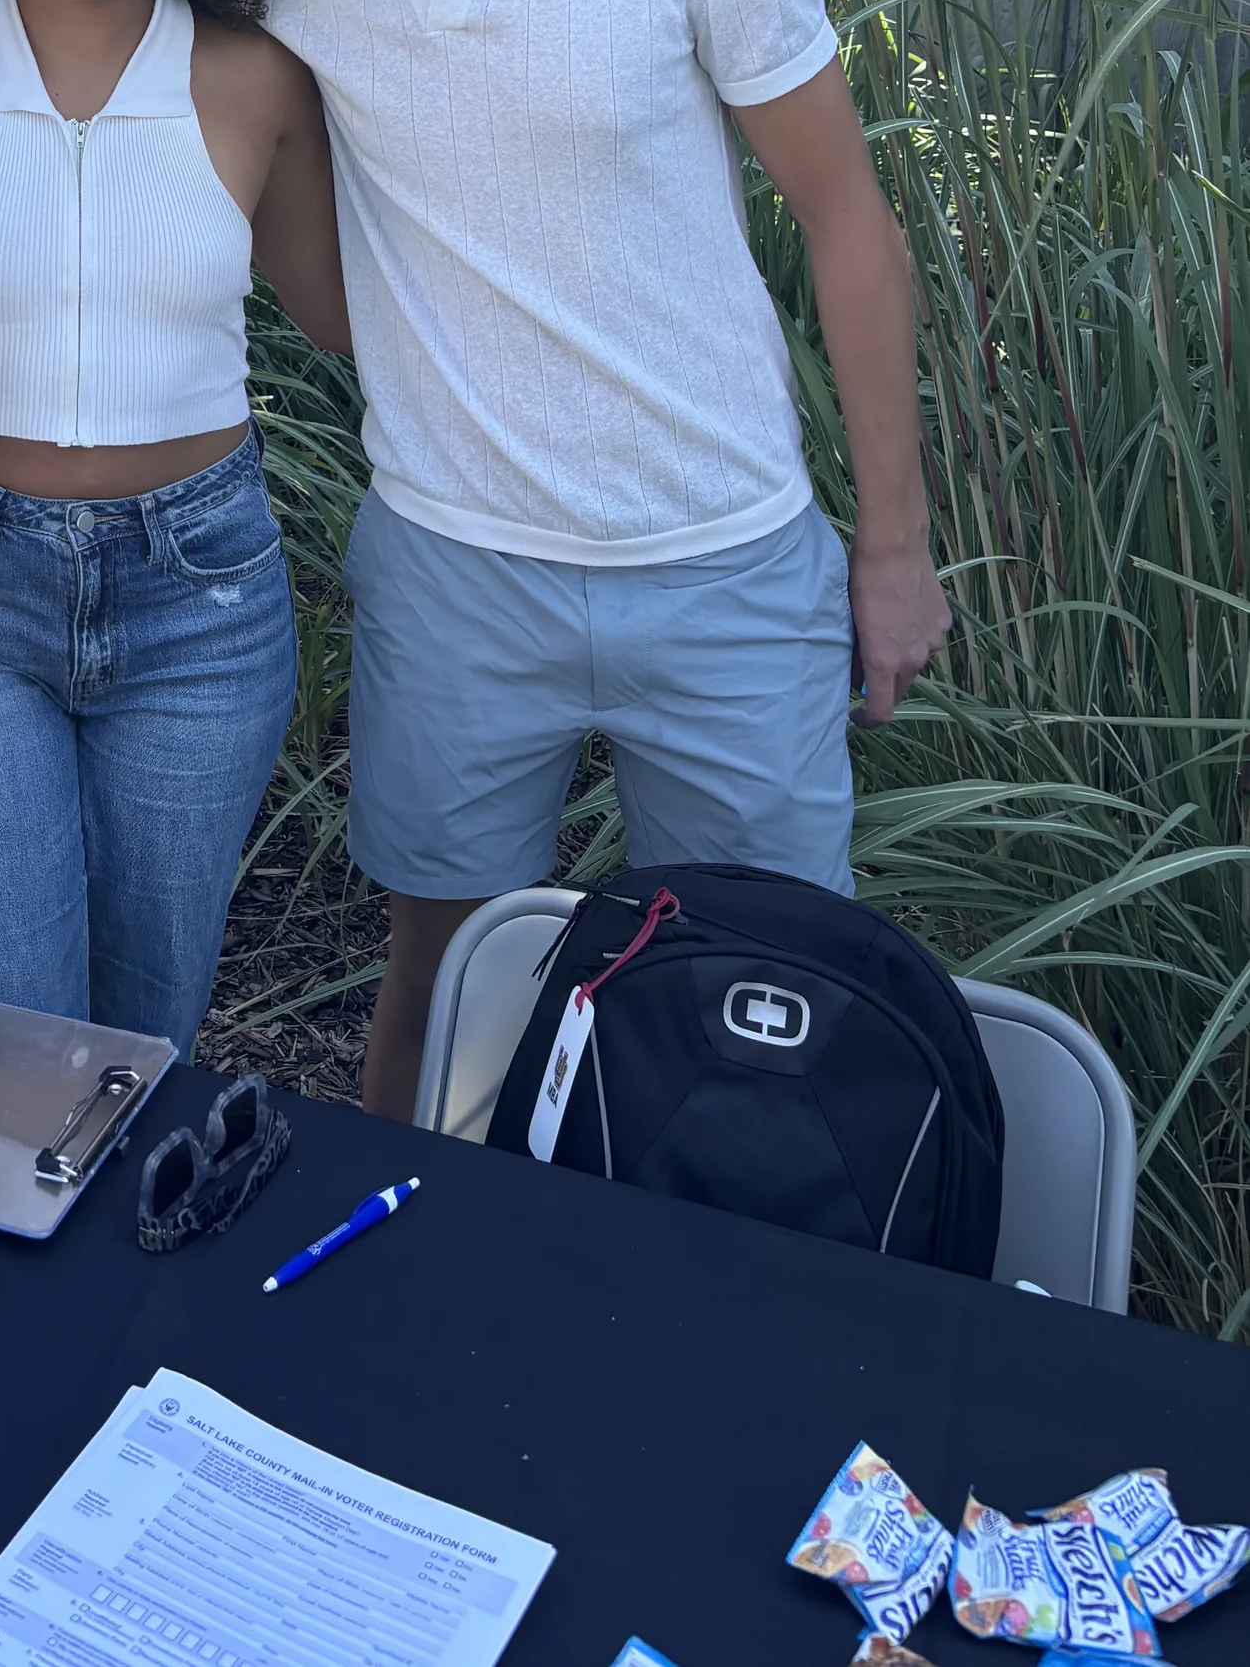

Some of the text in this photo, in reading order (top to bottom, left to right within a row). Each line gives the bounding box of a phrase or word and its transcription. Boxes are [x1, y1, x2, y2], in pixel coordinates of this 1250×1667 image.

[186, 1415, 498, 1565] SALT LAKE COUNTY MAIL-IN VOTER REGISTRATION FORM
[1099, 1474, 1156, 1516] Snacks
[1120, 1498, 1162, 1531] Fruit
[866, 1500, 905, 1564] Snacks
[884, 1520, 916, 1570] Fruit
[1000, 1527, 1026, 1591] Snacks
[1018, 1537, 1048, 1585] Fruit
[1051, 1525, 1124, 1645] Welch's
